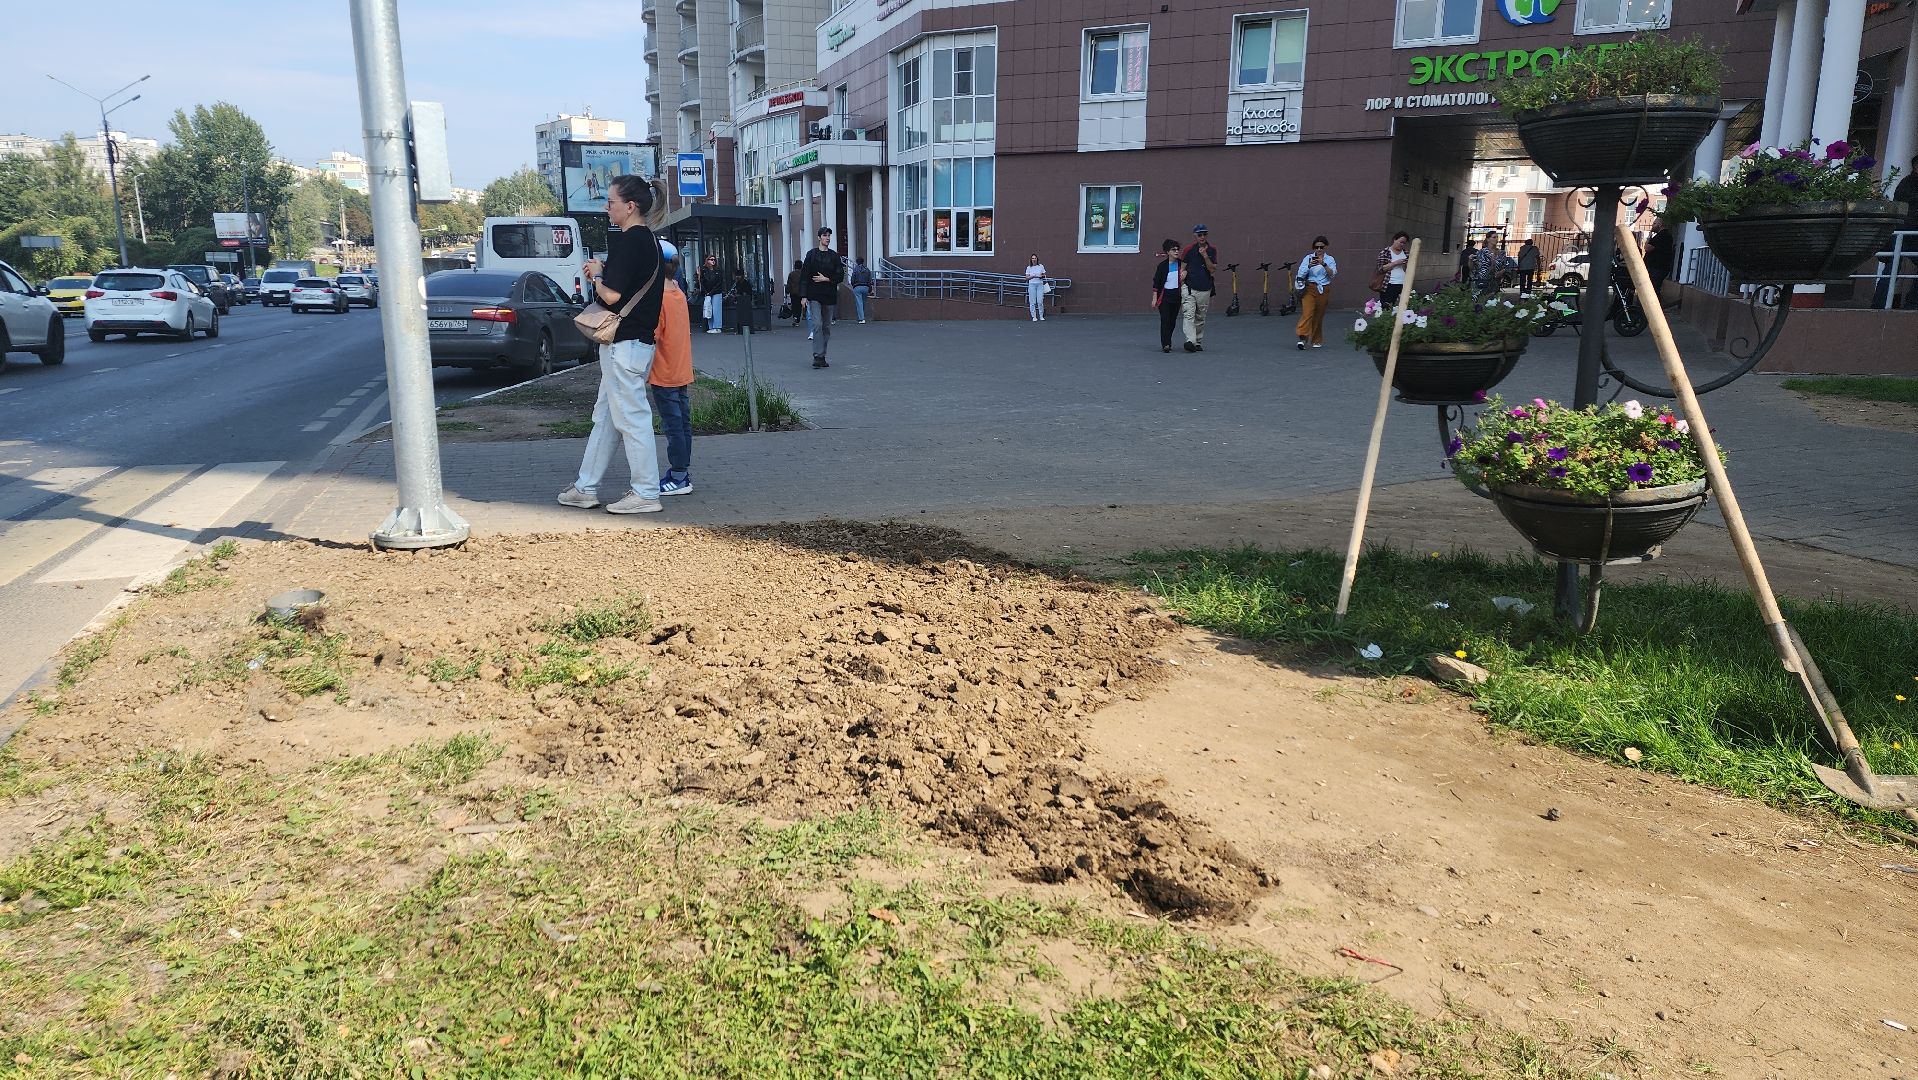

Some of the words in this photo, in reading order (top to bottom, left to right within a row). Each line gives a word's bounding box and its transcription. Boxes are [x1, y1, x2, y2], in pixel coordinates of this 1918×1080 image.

[1408, 43, 1643, 86] ЭКСТРОМ
[1365, 98, 1392, 111] ЛОР
[1394, 96, 1404, 109] И
[1406, 92, 1497, 108] СТОМАТОЛОГ
[1243, 107, 1282, 119] Класс
[1226, 125, 1243, 135] на
[1248, 120, 1298, 134] Чехова
